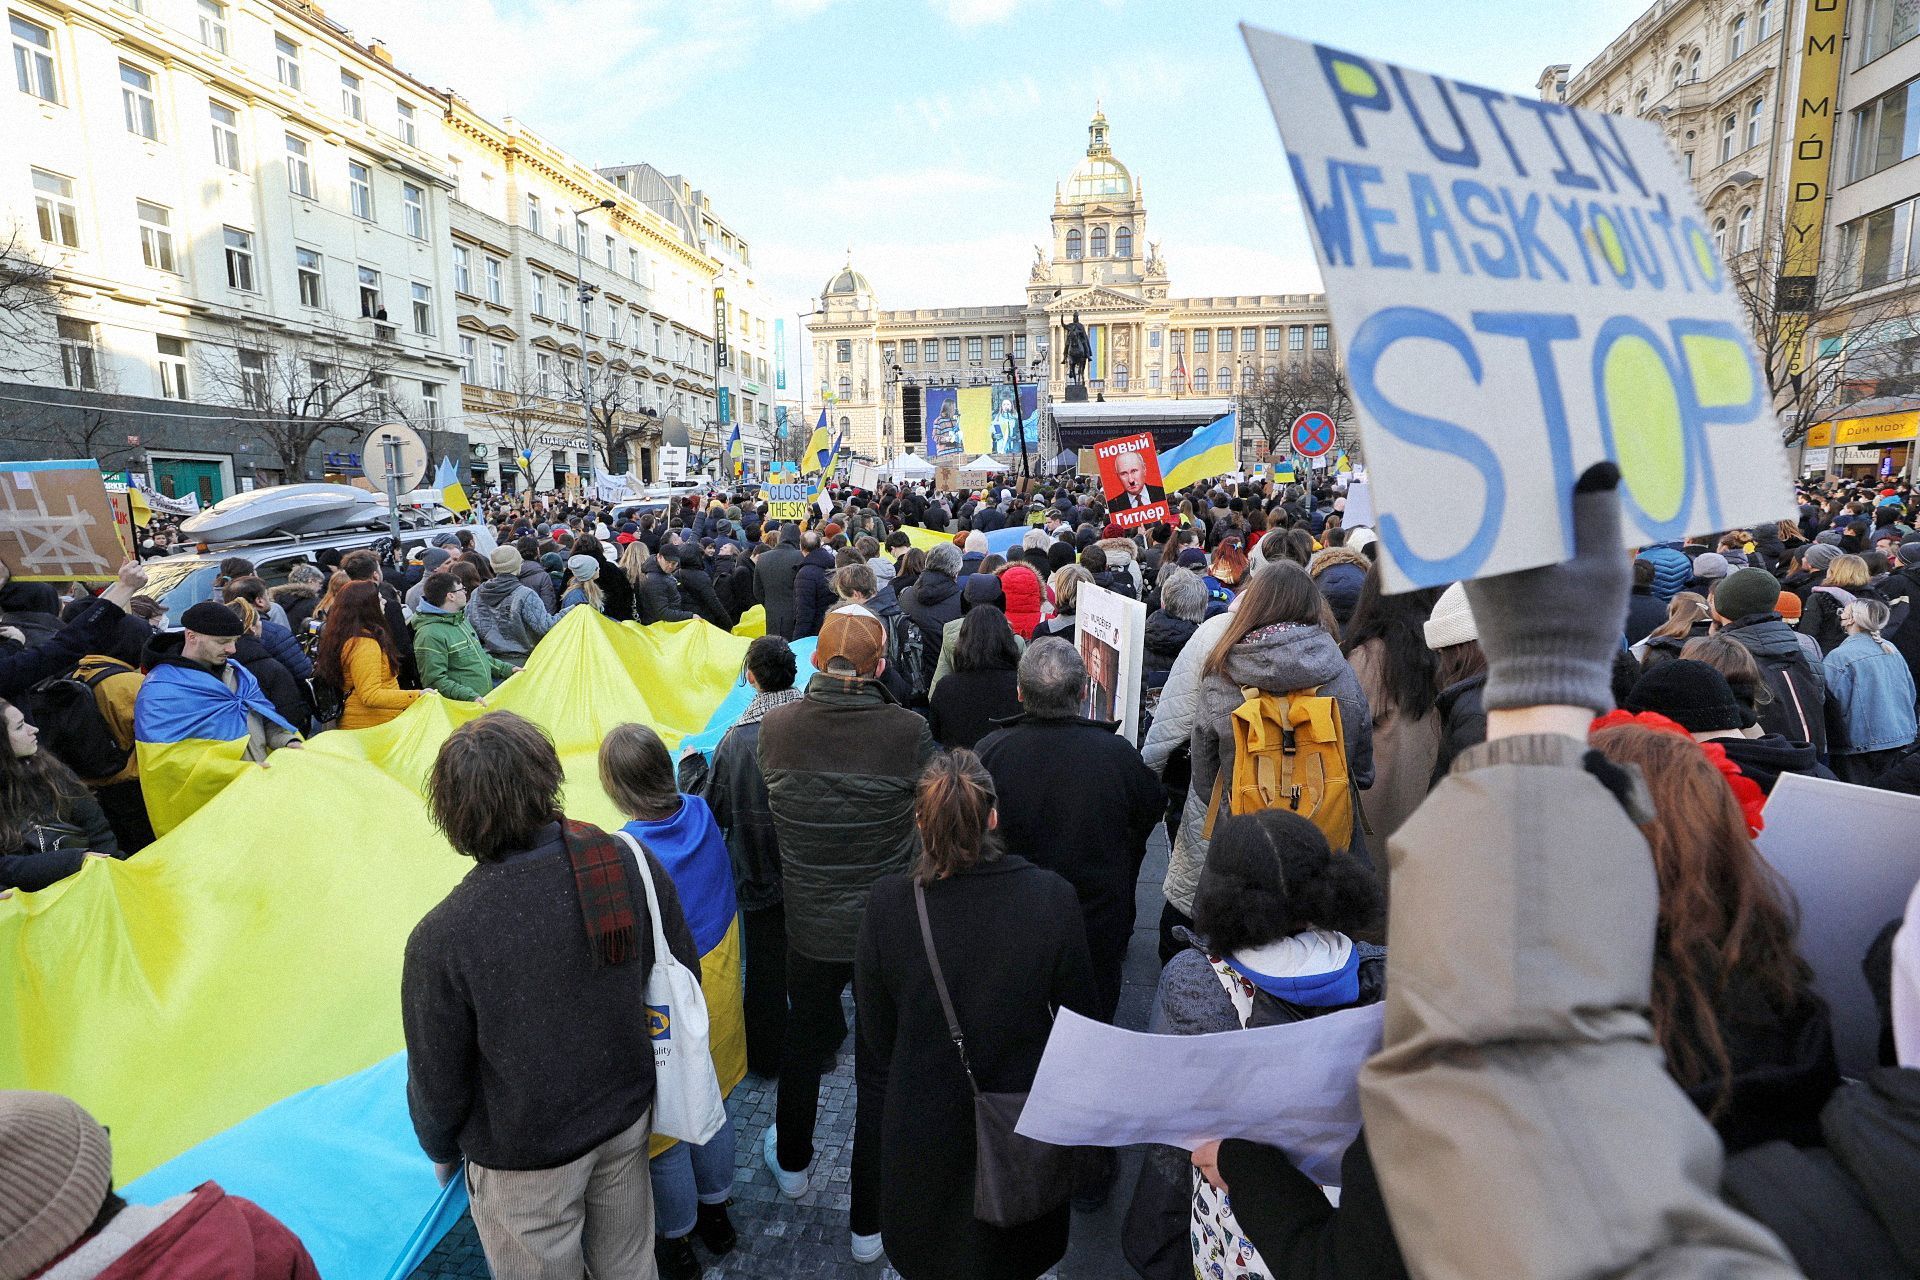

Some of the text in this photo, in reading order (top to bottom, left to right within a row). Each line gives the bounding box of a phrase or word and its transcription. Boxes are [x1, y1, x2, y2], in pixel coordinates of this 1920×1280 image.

[1791, 97, 1829, 243] MÓDY
[1286, 152, 1724, 294] WE ASK YOU TO
[541, 436, 580, 449] STARBUCKS
[1347, 306, 1764, 588] STOP
[1834, 450, 1879, 460] XCHANGE
[103, 482, 128, 490] ARKET
[769, 485, 807, 500] CLOSE
[769, 501, 807, 517] THE SKY
[1115, 505, 1166, 527] Гитлер
[654, 1046, 672, 1056] ality
